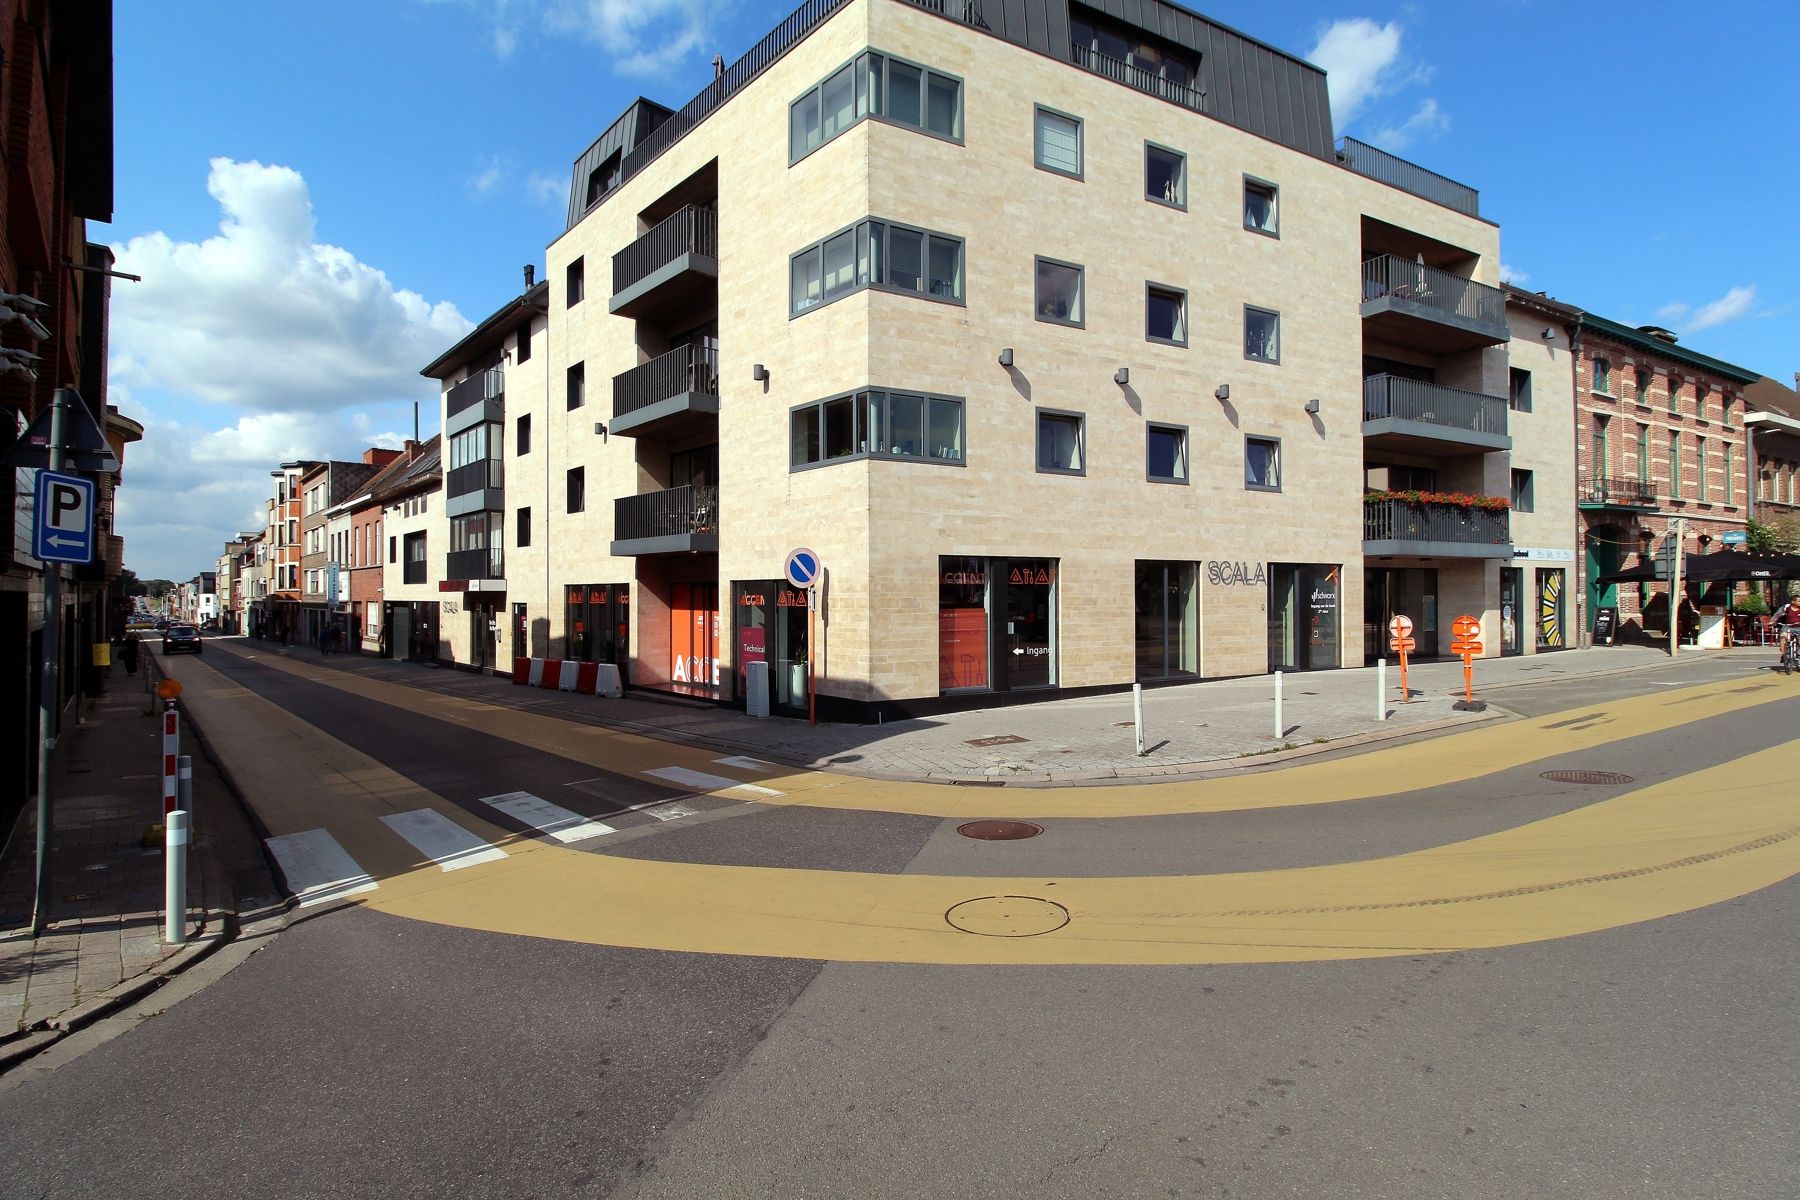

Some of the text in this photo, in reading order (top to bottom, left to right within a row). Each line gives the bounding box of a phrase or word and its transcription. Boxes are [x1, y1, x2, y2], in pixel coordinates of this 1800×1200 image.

[52, 483, 82, 528] P
[1208, 560, 1267, 586] SCALA
[743, 643, 766, 654] Technical
[1026, 646, 1053, 657] Ingang
